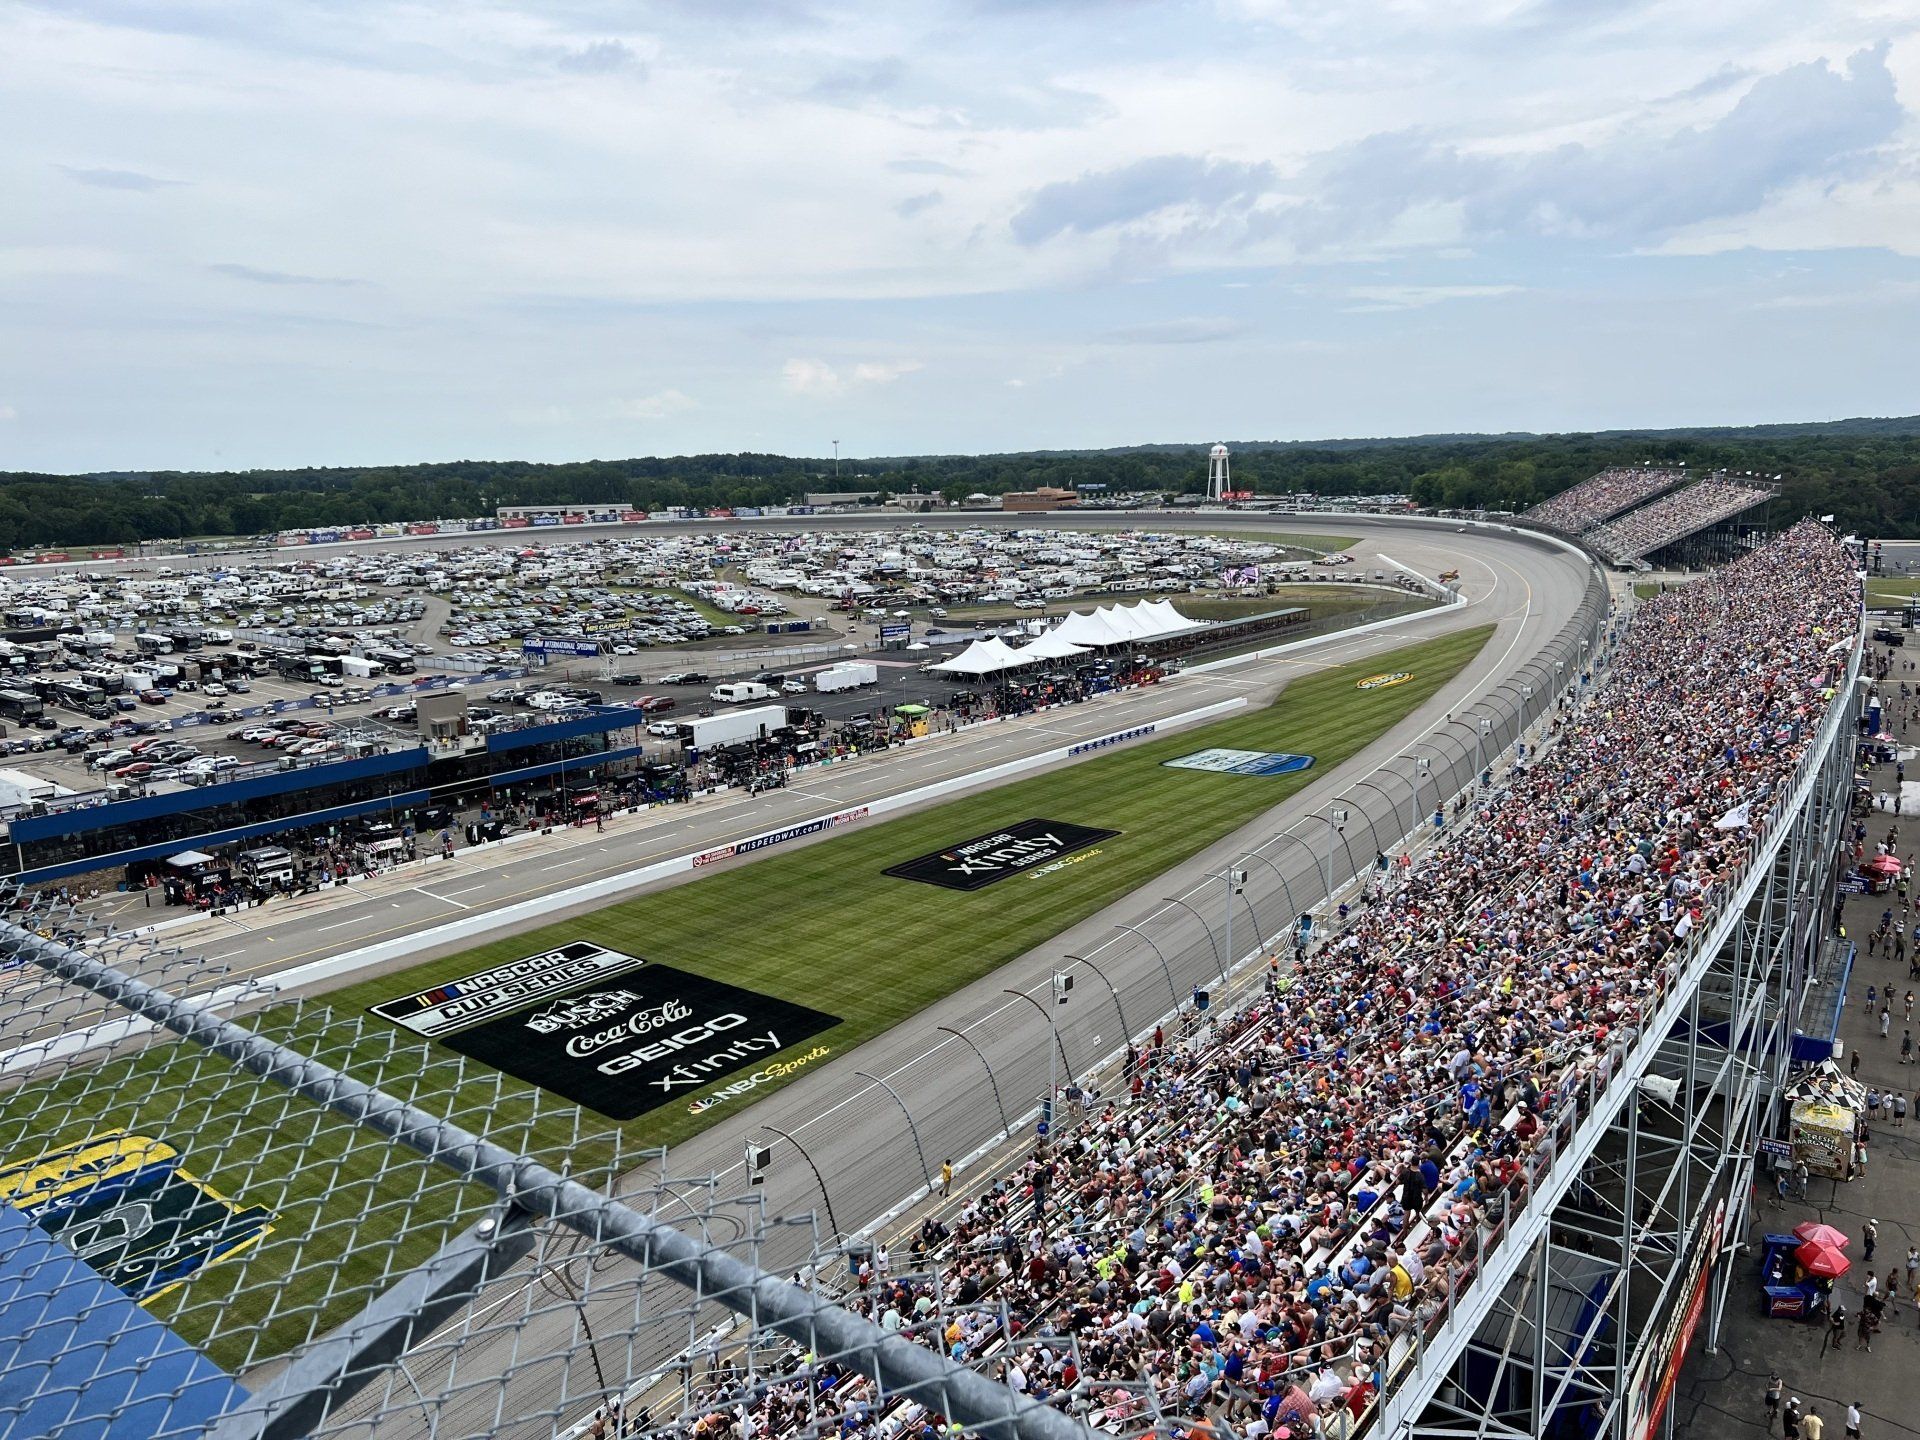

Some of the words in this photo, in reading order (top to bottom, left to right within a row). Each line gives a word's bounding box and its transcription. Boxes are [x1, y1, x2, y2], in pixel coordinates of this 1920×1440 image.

[1054, 616, 1065, 624] TO
[740, 824, 820, 853] MISPEEDWAY.com
[956, 833, 1017, 856] NASCAR
[947, 833, 1065, 876] xfinity
[1010, 848, 1058, 868] SERIES
[1041, 857, 1074, 875] NBC
[456, 951, 571, 995] NASCAR
[439, 994, 501, 1019] CUP
[502, 960, 600, 998] SERIES
[525, 989, 644, 1034] BUSCH
[567, 1001, 635, 1029] LIGHT
[565, 998, 693, 1058] Coca-Cola
[597, 1013, 749, 1076] GEICO
[648, 1030, 782, 1092] xfinity
[714, 1071, 774, 1100] NBC
[765, 1045, 831, 1077] Sports
[1762, 1140, 1790, 1150] SECTIONS
[1793, 1139, 1848, 1156] MARGARITAS
[1807, 1133, 1835, 1145] FRESH
